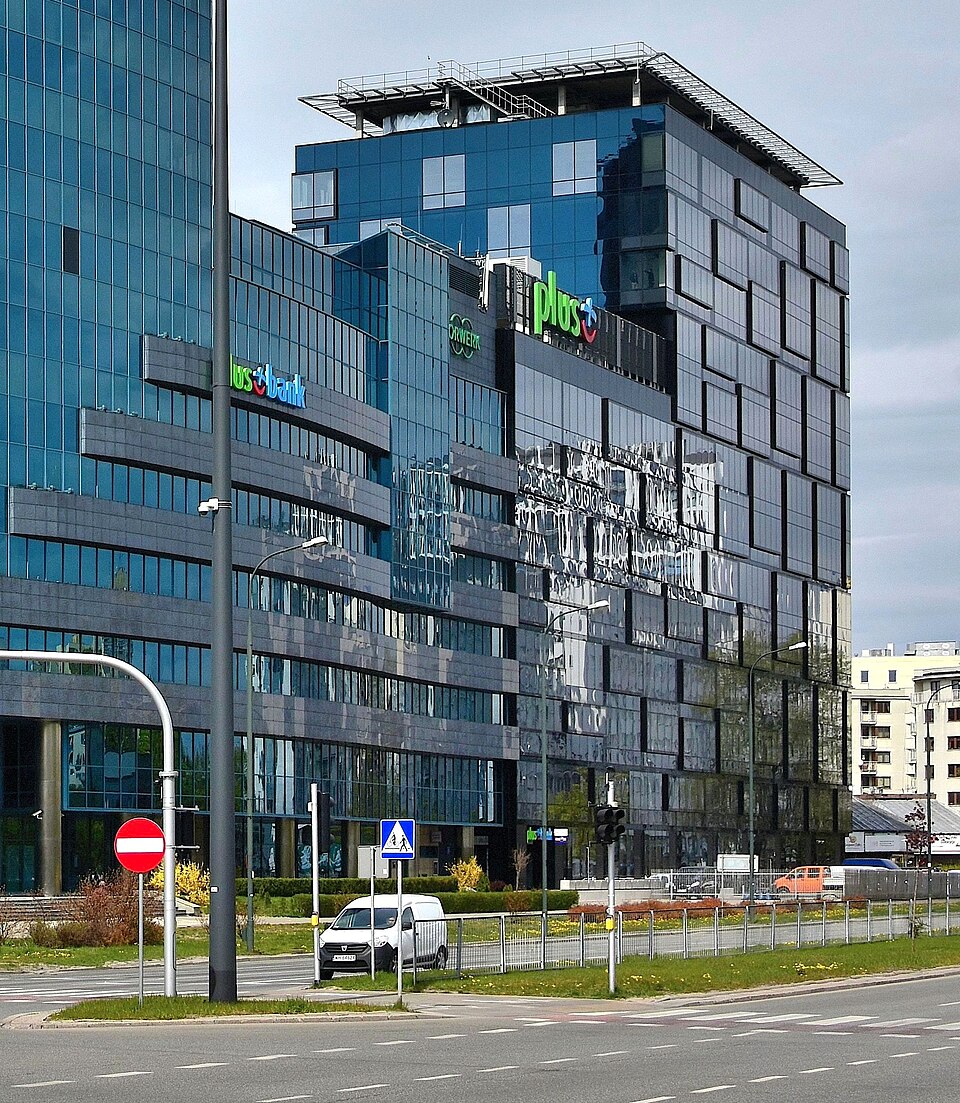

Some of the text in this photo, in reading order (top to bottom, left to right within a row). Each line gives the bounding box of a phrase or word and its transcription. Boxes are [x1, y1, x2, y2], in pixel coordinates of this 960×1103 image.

[534, 271, 580, 336] plus
[449, 324, 480, 350] ORWERK
[265, 363, 307, 408] bank
